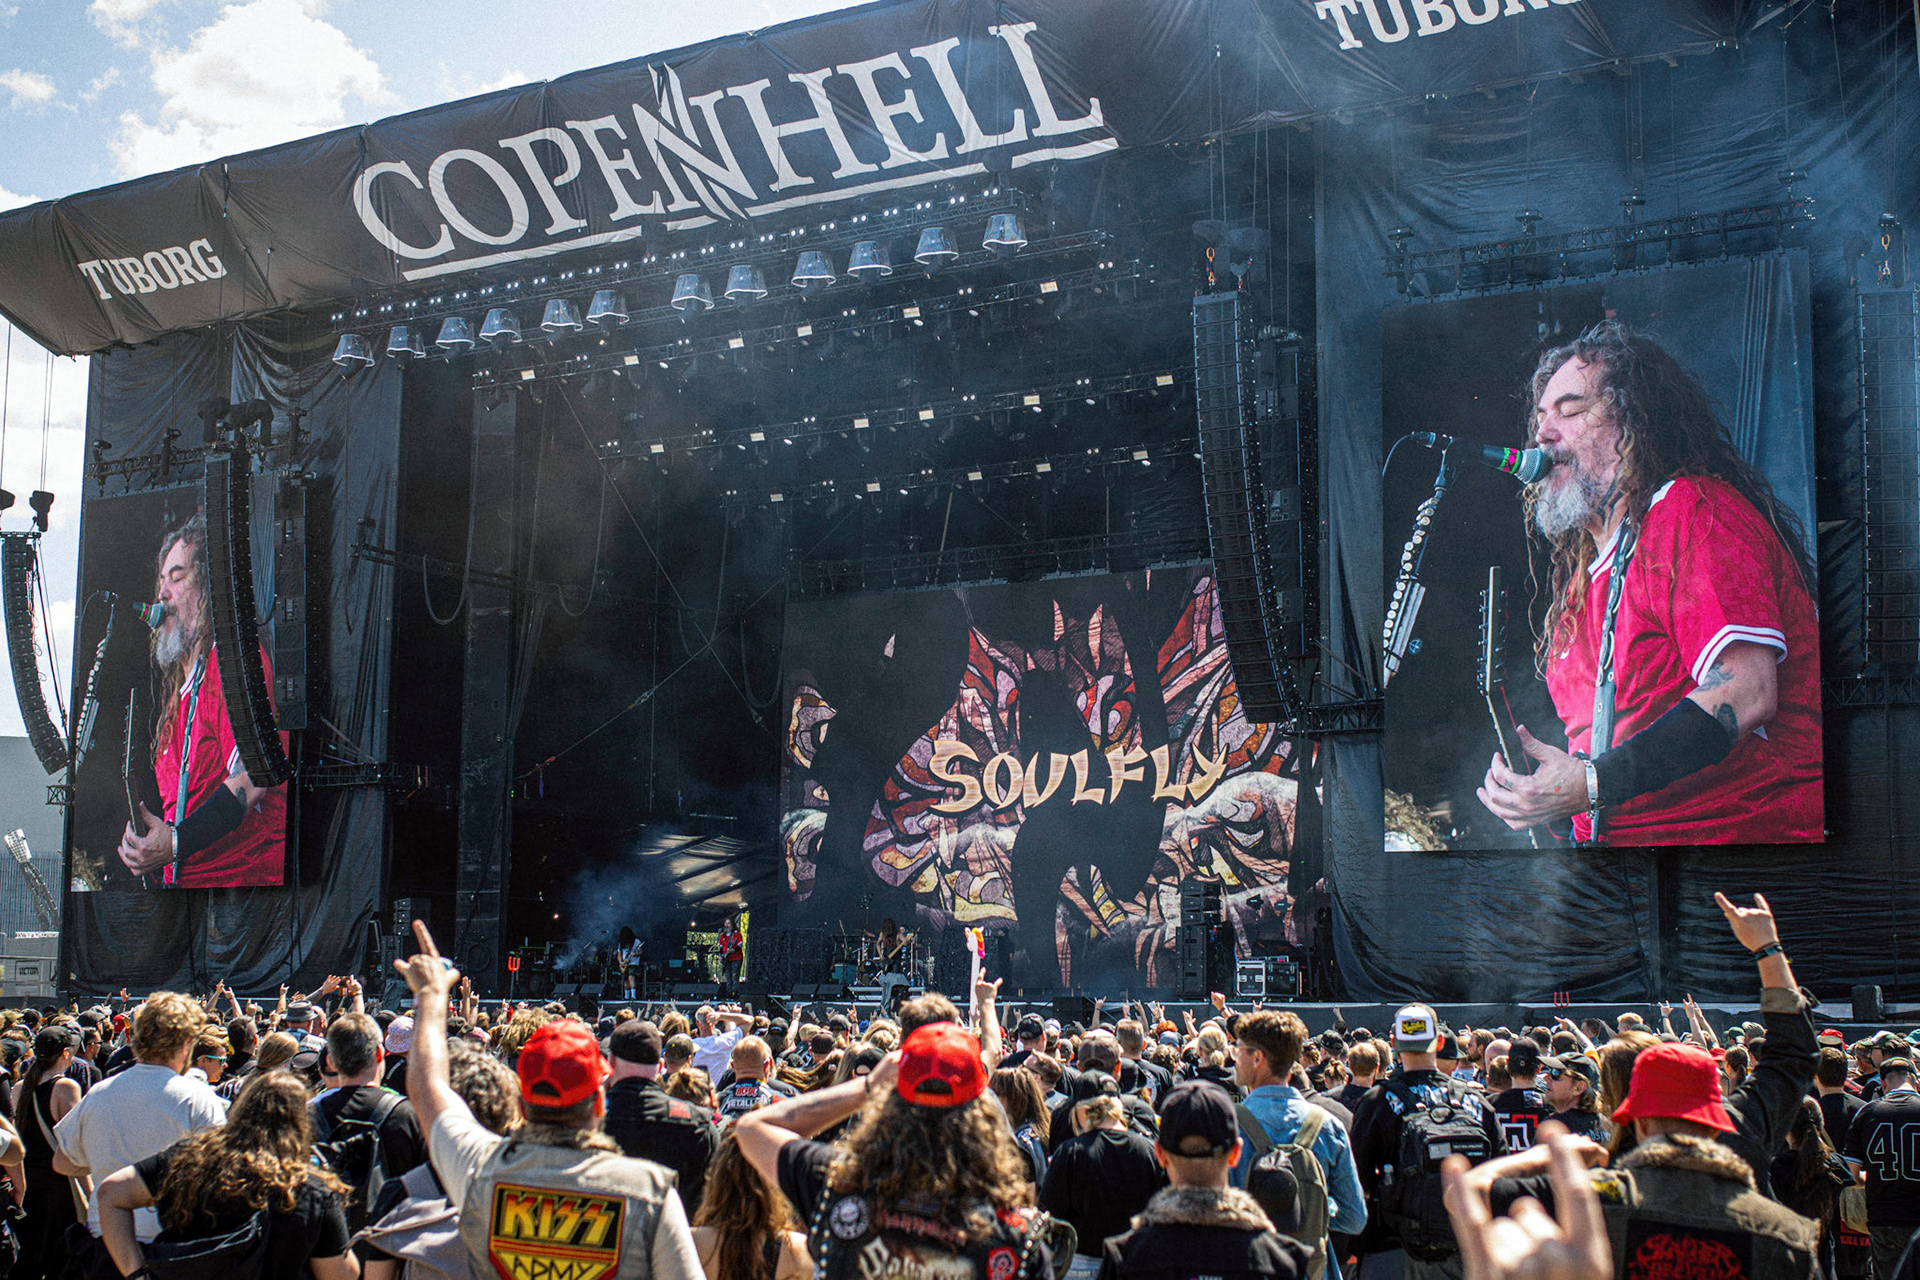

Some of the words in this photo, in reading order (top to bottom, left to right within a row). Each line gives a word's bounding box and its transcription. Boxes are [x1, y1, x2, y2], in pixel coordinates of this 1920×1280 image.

[1314, 0, 1585, 50] TUBO
[353, 22, 1104, 260] COPENHELL
[78, 237, 228, 300] TUBORG
[927, 736, 1229, 812] SOULFLY
[500, 1191, 615, 1246] KISS
